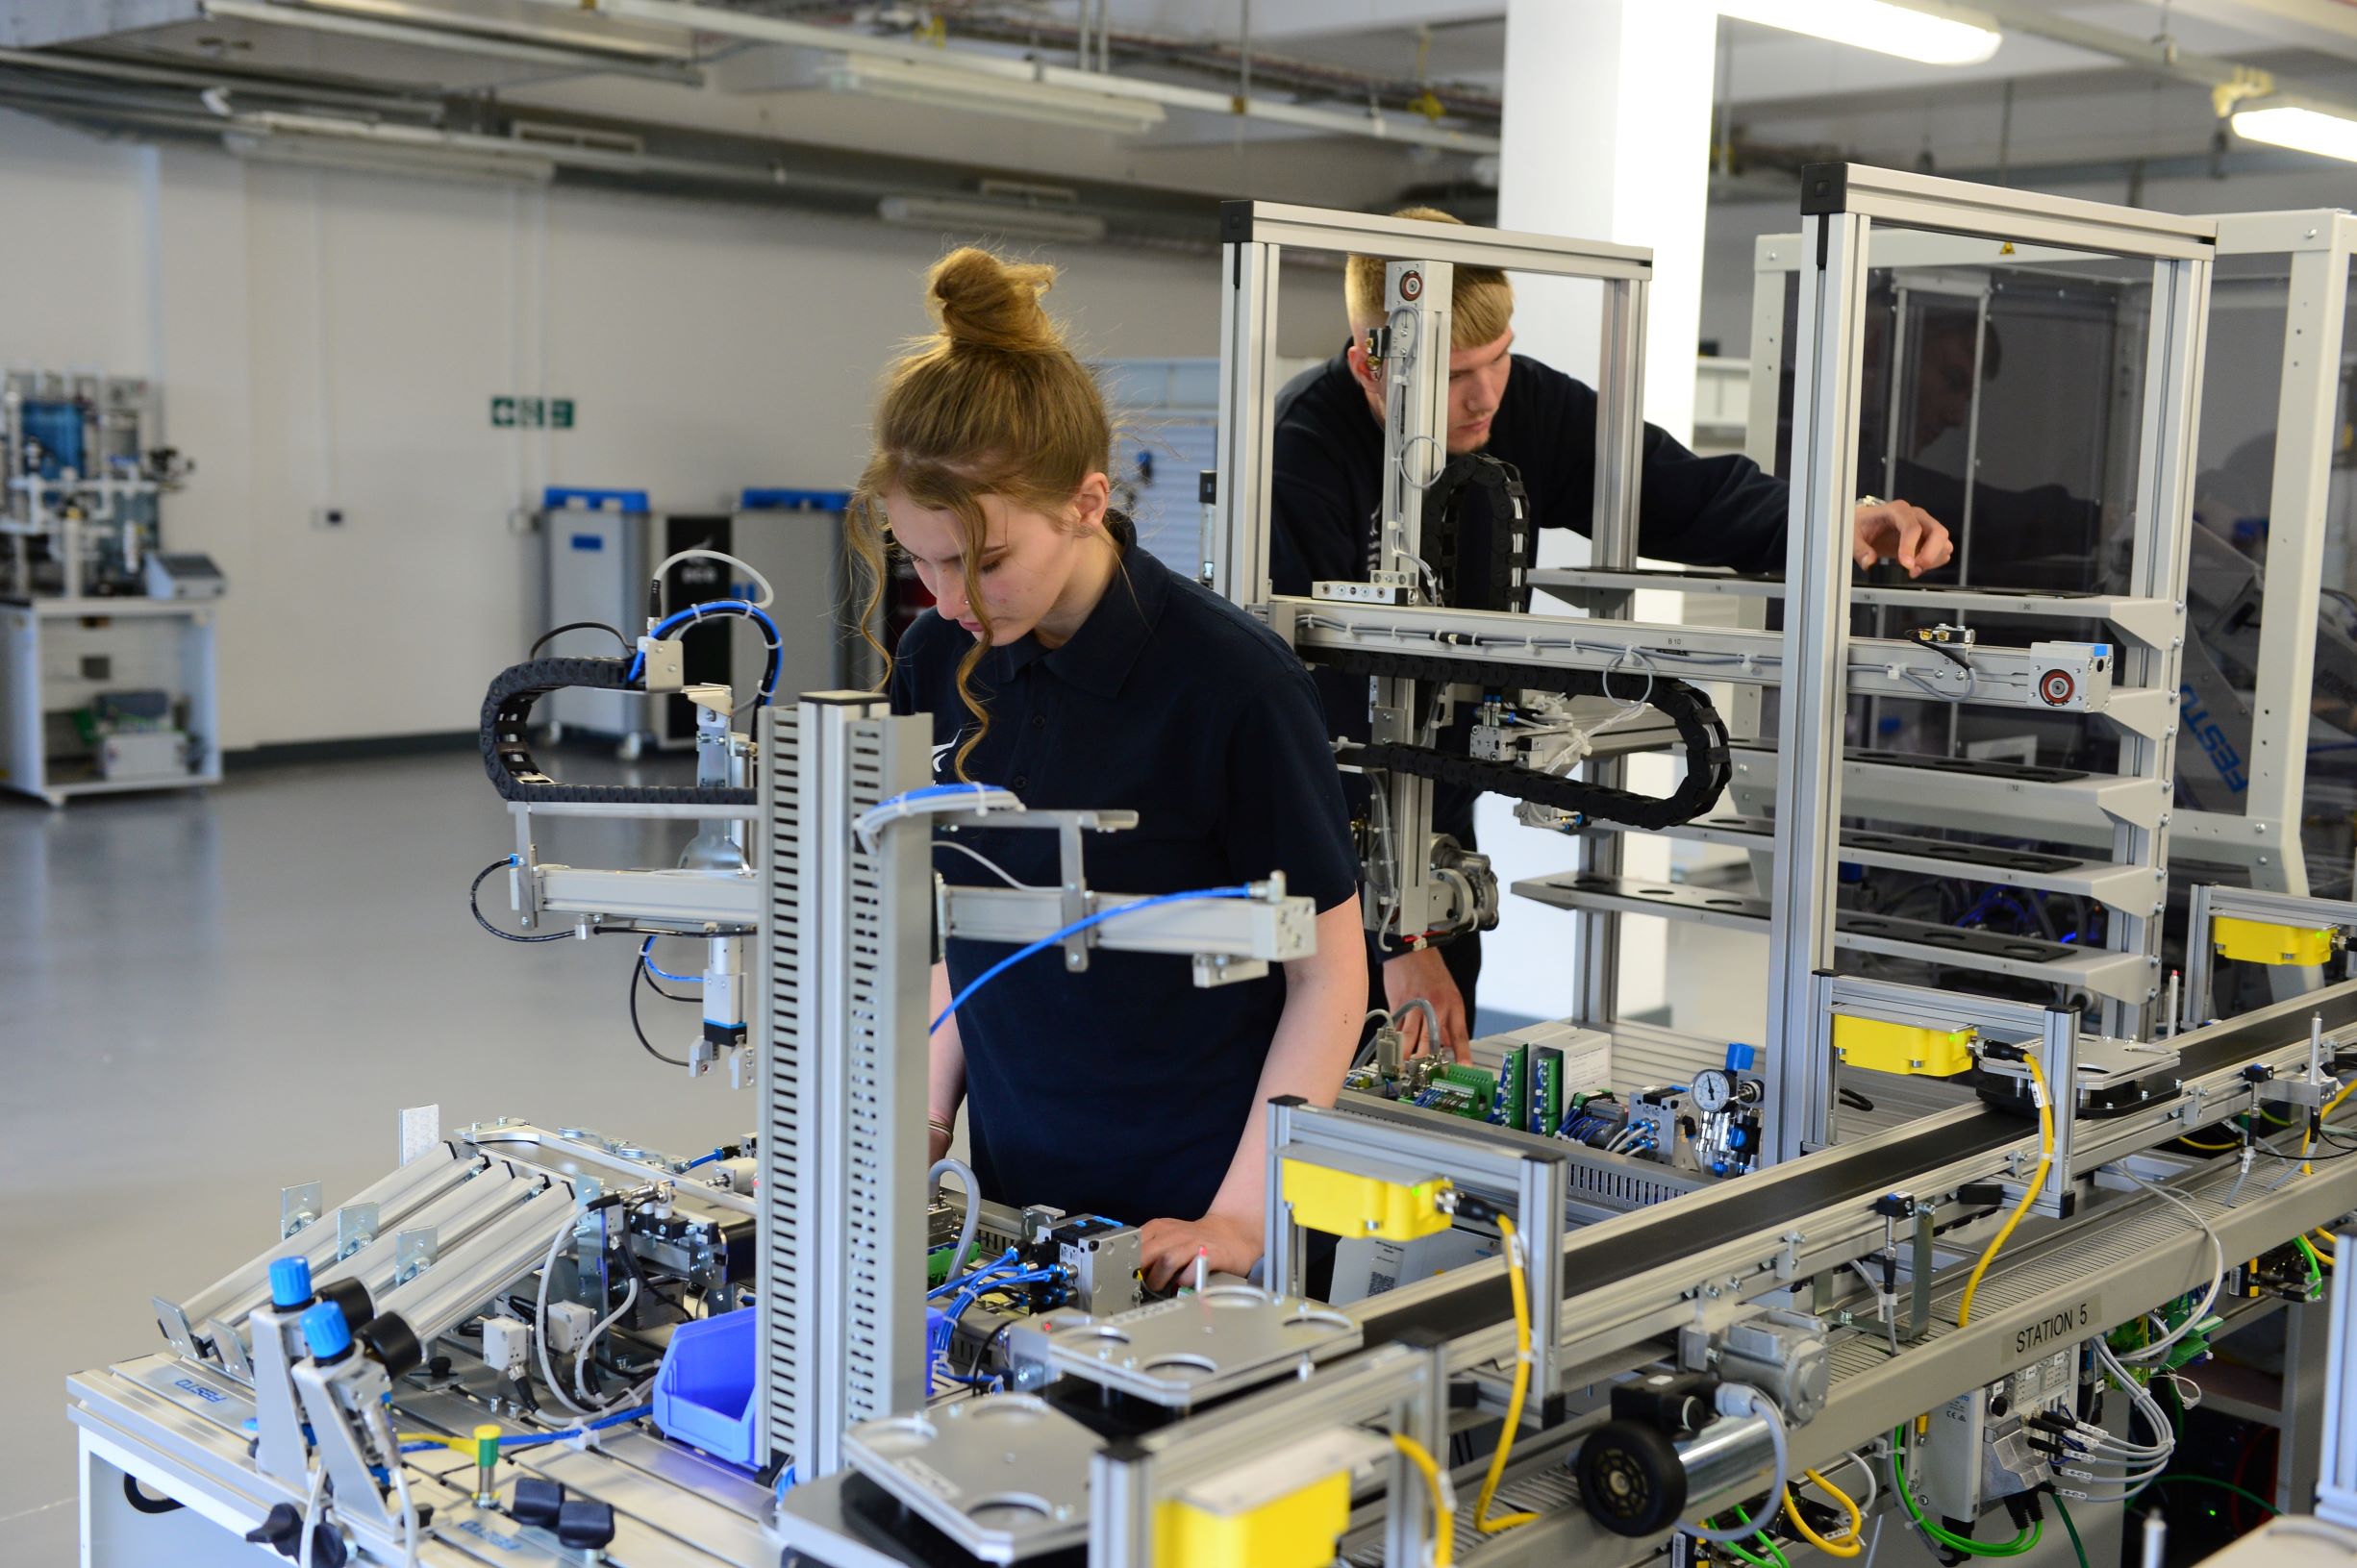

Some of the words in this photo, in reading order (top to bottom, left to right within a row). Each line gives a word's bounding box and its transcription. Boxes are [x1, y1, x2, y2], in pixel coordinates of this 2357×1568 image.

[2016, 1308, 2072, 1354] STATION
[2079, 1303, 2088, 1326] 5
[175, 1379, 228, 1403] FESTO
